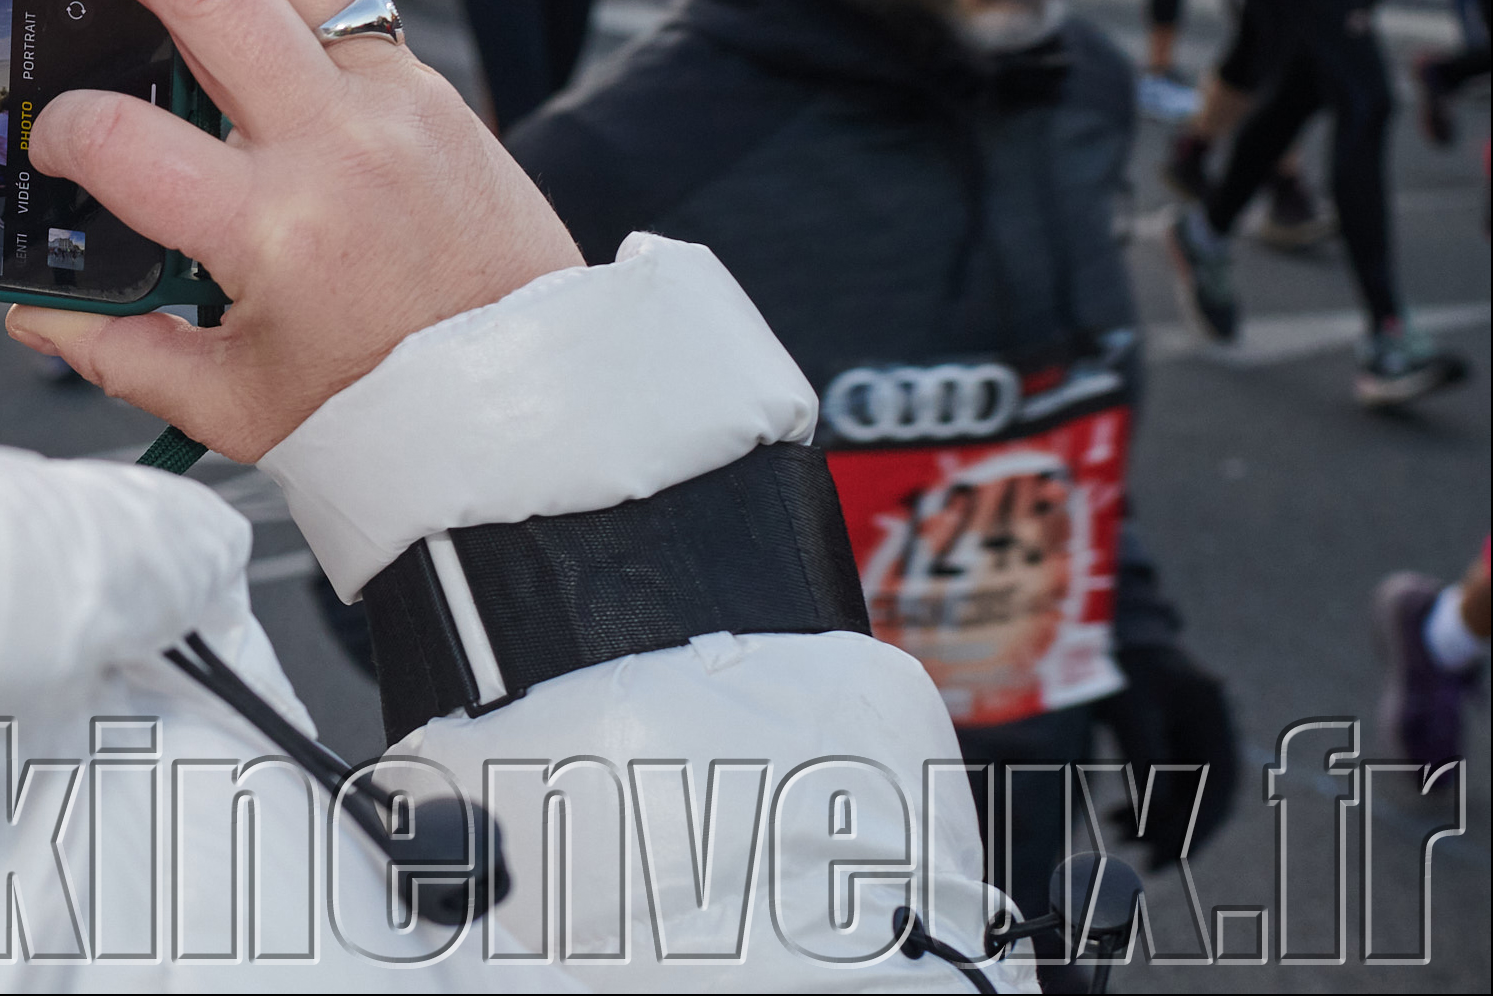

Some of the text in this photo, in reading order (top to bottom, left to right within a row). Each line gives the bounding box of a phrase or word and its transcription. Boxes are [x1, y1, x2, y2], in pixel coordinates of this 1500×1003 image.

[22, 11, 36, 80] PORTRAIT
[20, 100, 33, 150] PHOTO
[15, 171, 30, 214] VIDÉO
